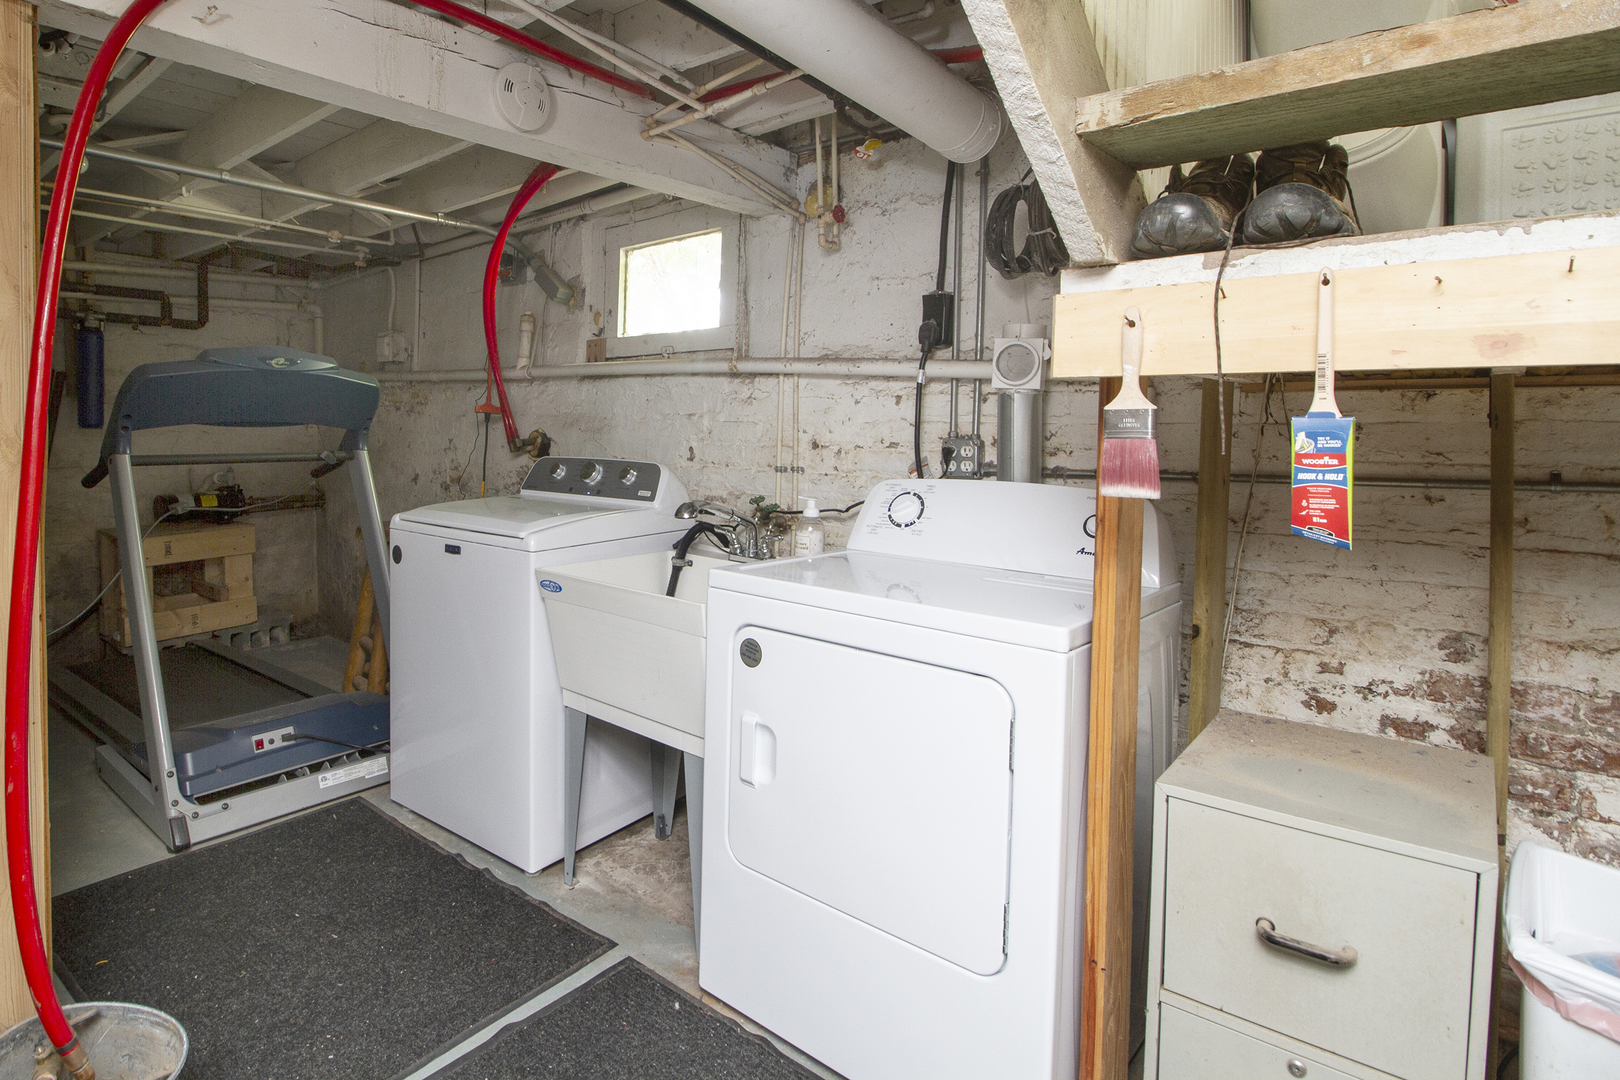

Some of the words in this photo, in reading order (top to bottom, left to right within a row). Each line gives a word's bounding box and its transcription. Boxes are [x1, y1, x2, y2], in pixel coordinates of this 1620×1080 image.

[1297, 472, 1317, 480] HOOK
[1317, 472, 1323, 480] &
[1324, 473, 1345, 481] HOLD
